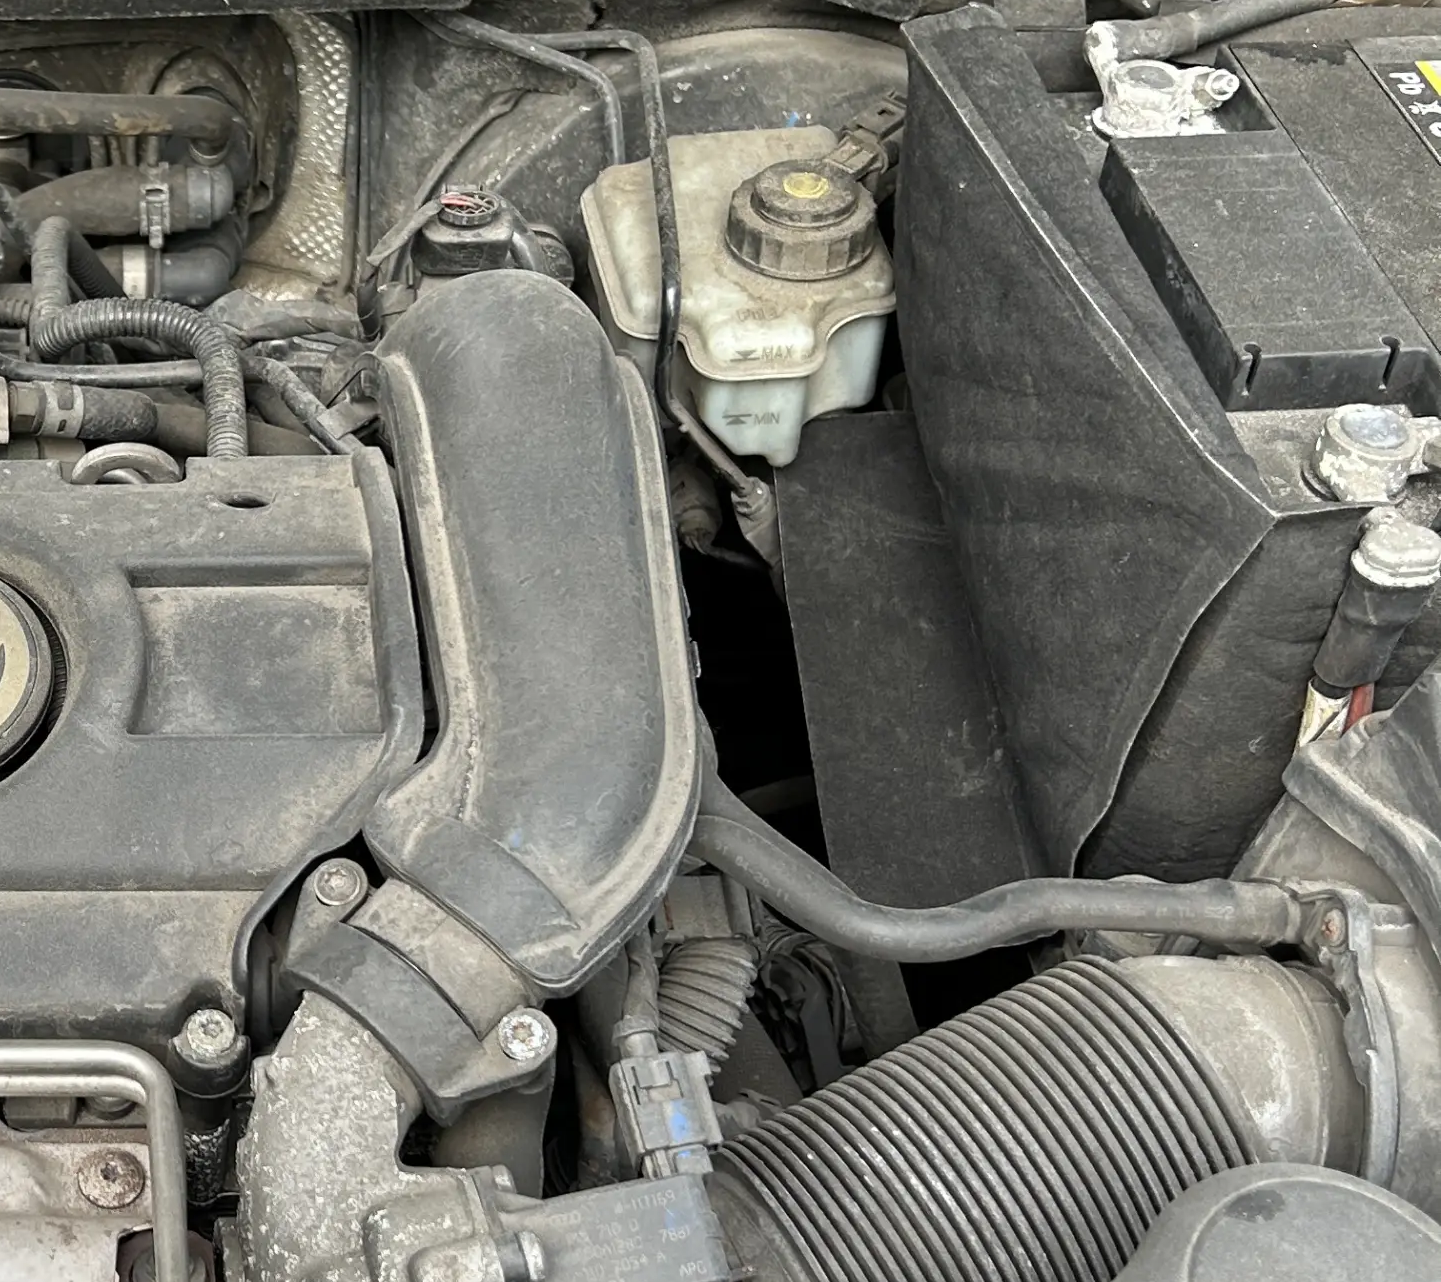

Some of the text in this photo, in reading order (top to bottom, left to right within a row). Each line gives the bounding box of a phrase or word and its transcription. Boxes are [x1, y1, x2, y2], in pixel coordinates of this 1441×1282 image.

[1388, 72, 1426, 95] Pb
[761, 345, 794, 360] MAX
[754, 413, 780, 425] MIN
